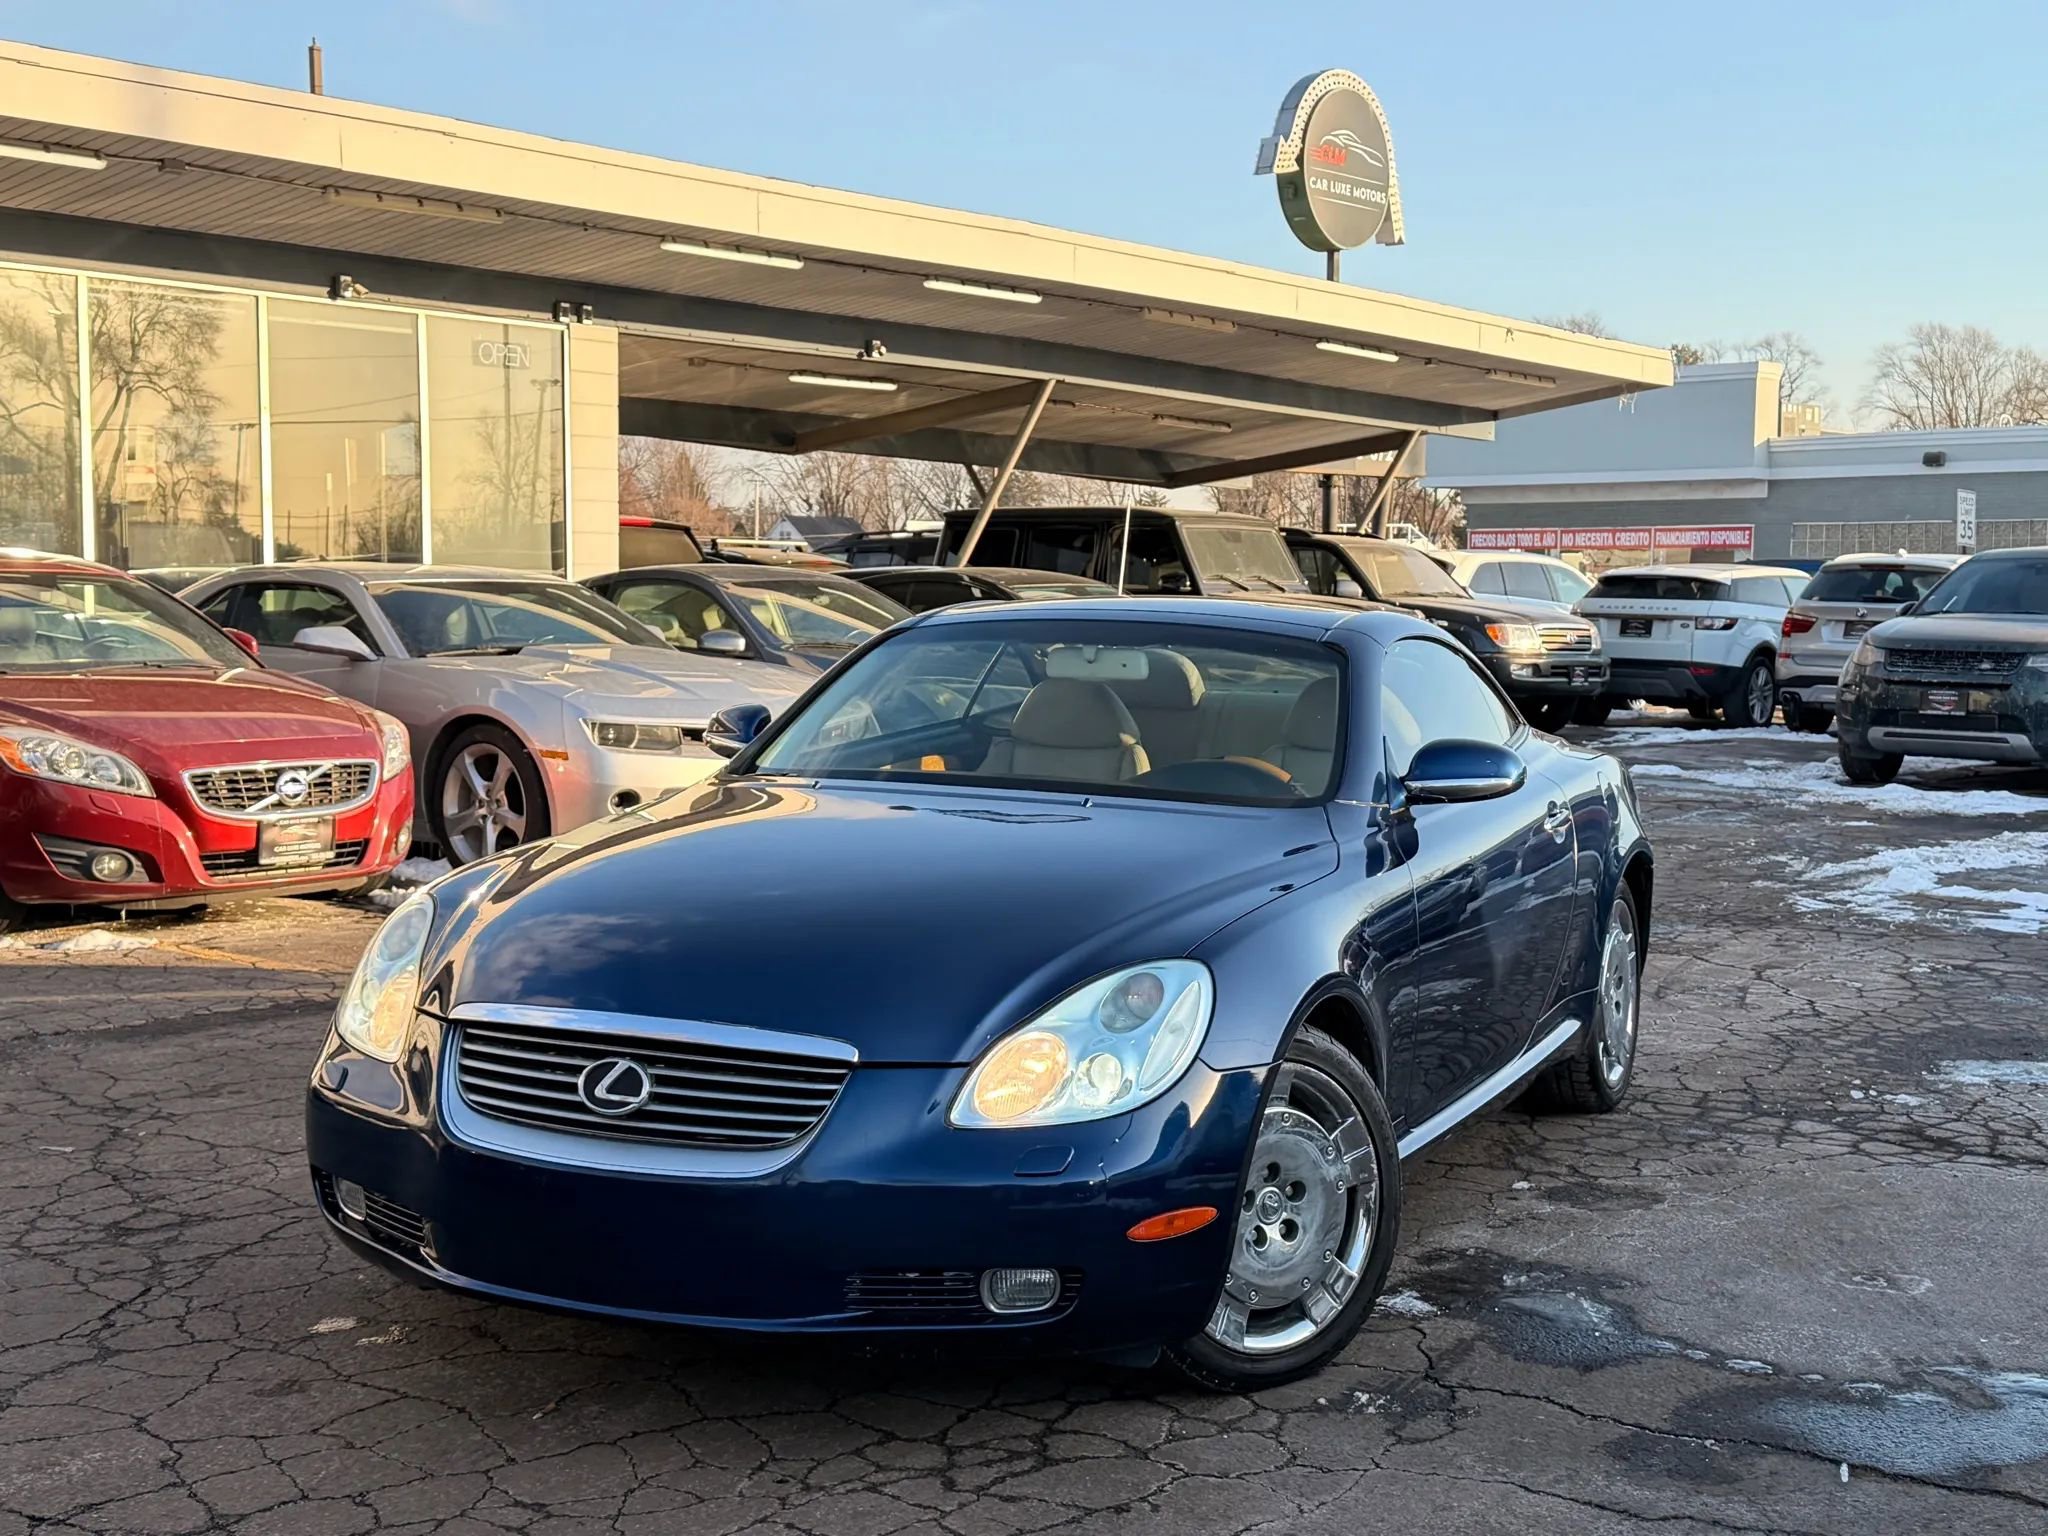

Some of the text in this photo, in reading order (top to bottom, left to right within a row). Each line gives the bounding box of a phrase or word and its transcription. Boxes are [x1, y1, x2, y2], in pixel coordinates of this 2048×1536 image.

[1310, 176, 1386, 204] CAR LUXE MOTORS
[479, 342, 530, 367] OPEN
[1562, 531, 1649, 546] NO NECESITA CREDITO
[1655, 530, 1750, 546] FINANCIAMIENTO DISPONIBLE
[1960, 519, 1974, 540] 35
[1471, 531, 1556, 547] PRECIOS BAJOS TODO EL AÑO
